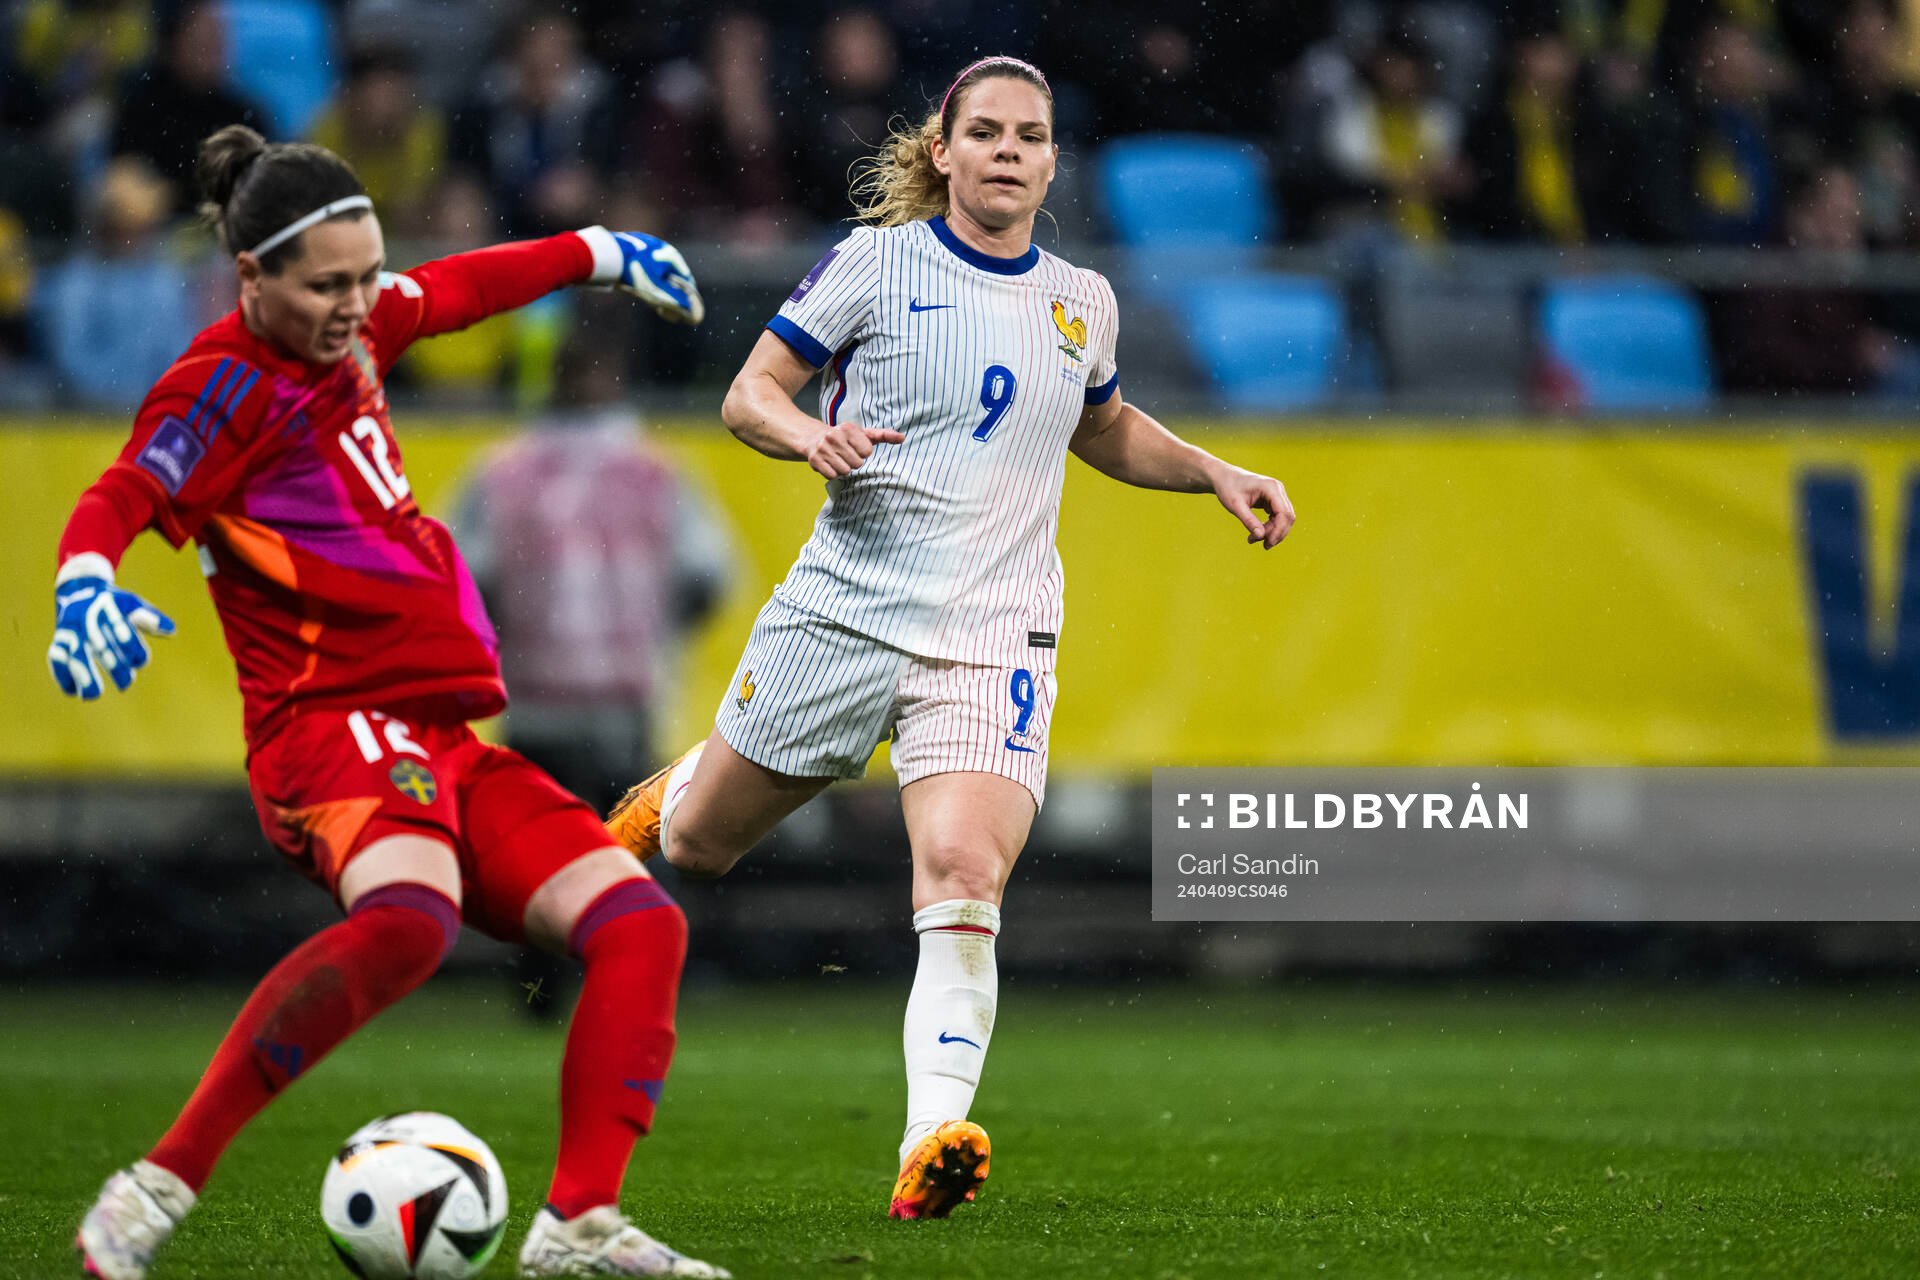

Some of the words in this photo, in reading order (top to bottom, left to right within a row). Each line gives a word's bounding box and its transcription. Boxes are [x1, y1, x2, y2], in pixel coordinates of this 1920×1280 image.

[972, 364, 1018, 443] 9
[338, 414, 411, 510] 12
[1010, 668, 1035, 738] 9
